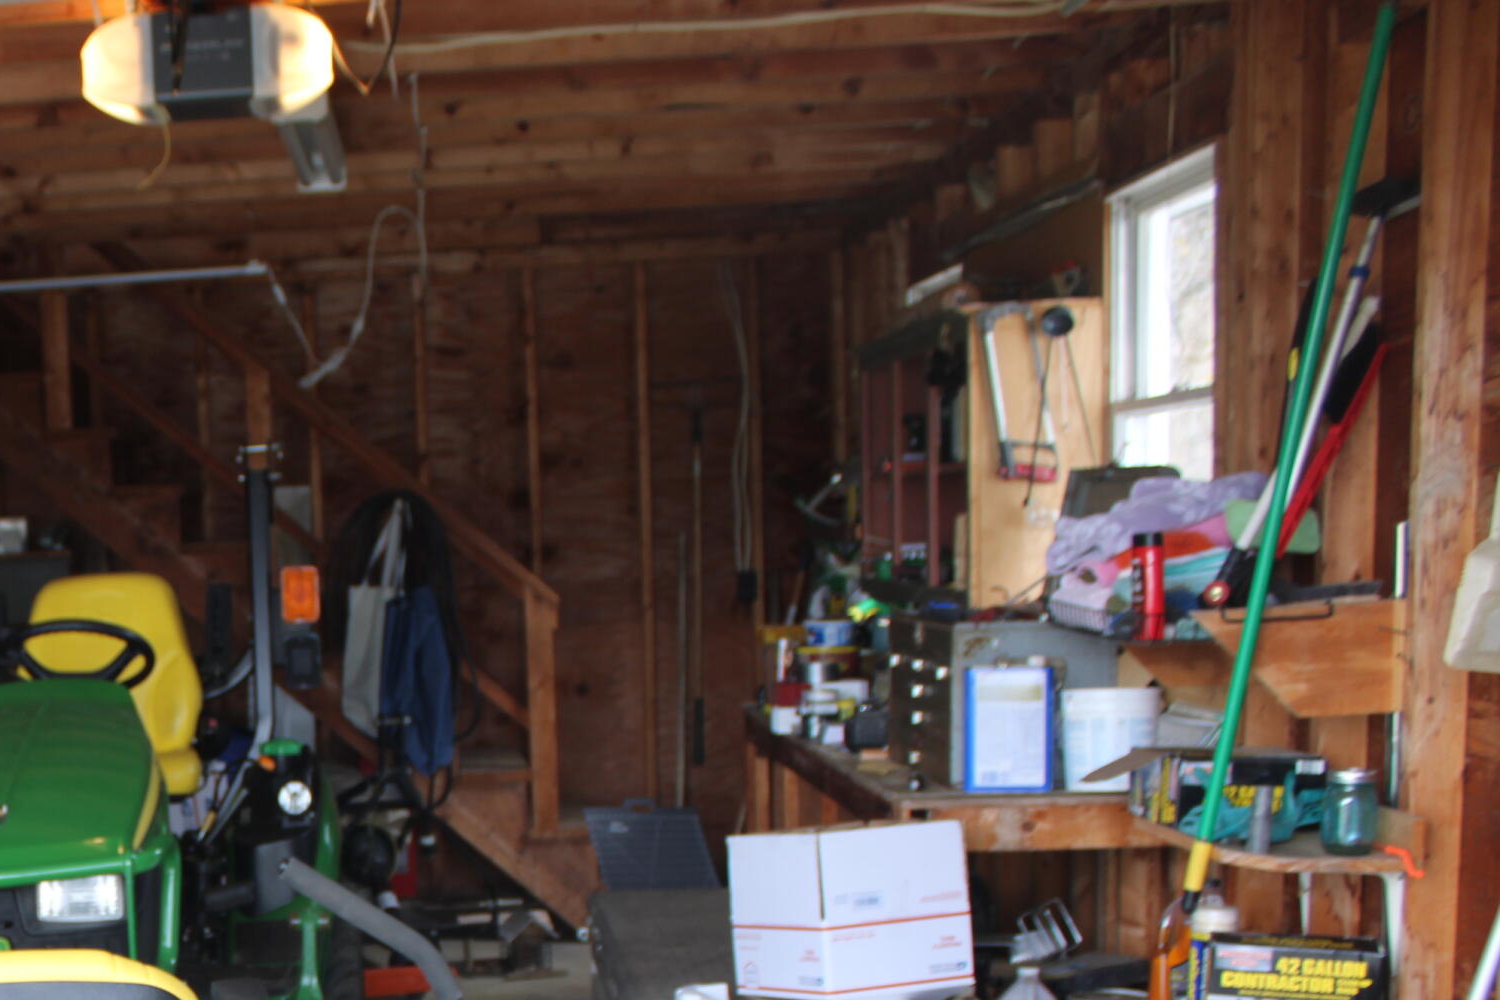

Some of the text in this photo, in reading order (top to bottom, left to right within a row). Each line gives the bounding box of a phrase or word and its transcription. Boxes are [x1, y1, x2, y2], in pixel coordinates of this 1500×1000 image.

[1276, 956, 1300, 975] 42
[1302, 958, 1368, 979] GALLON
[1220, 970, 1335, 993] CONTRACTOR
